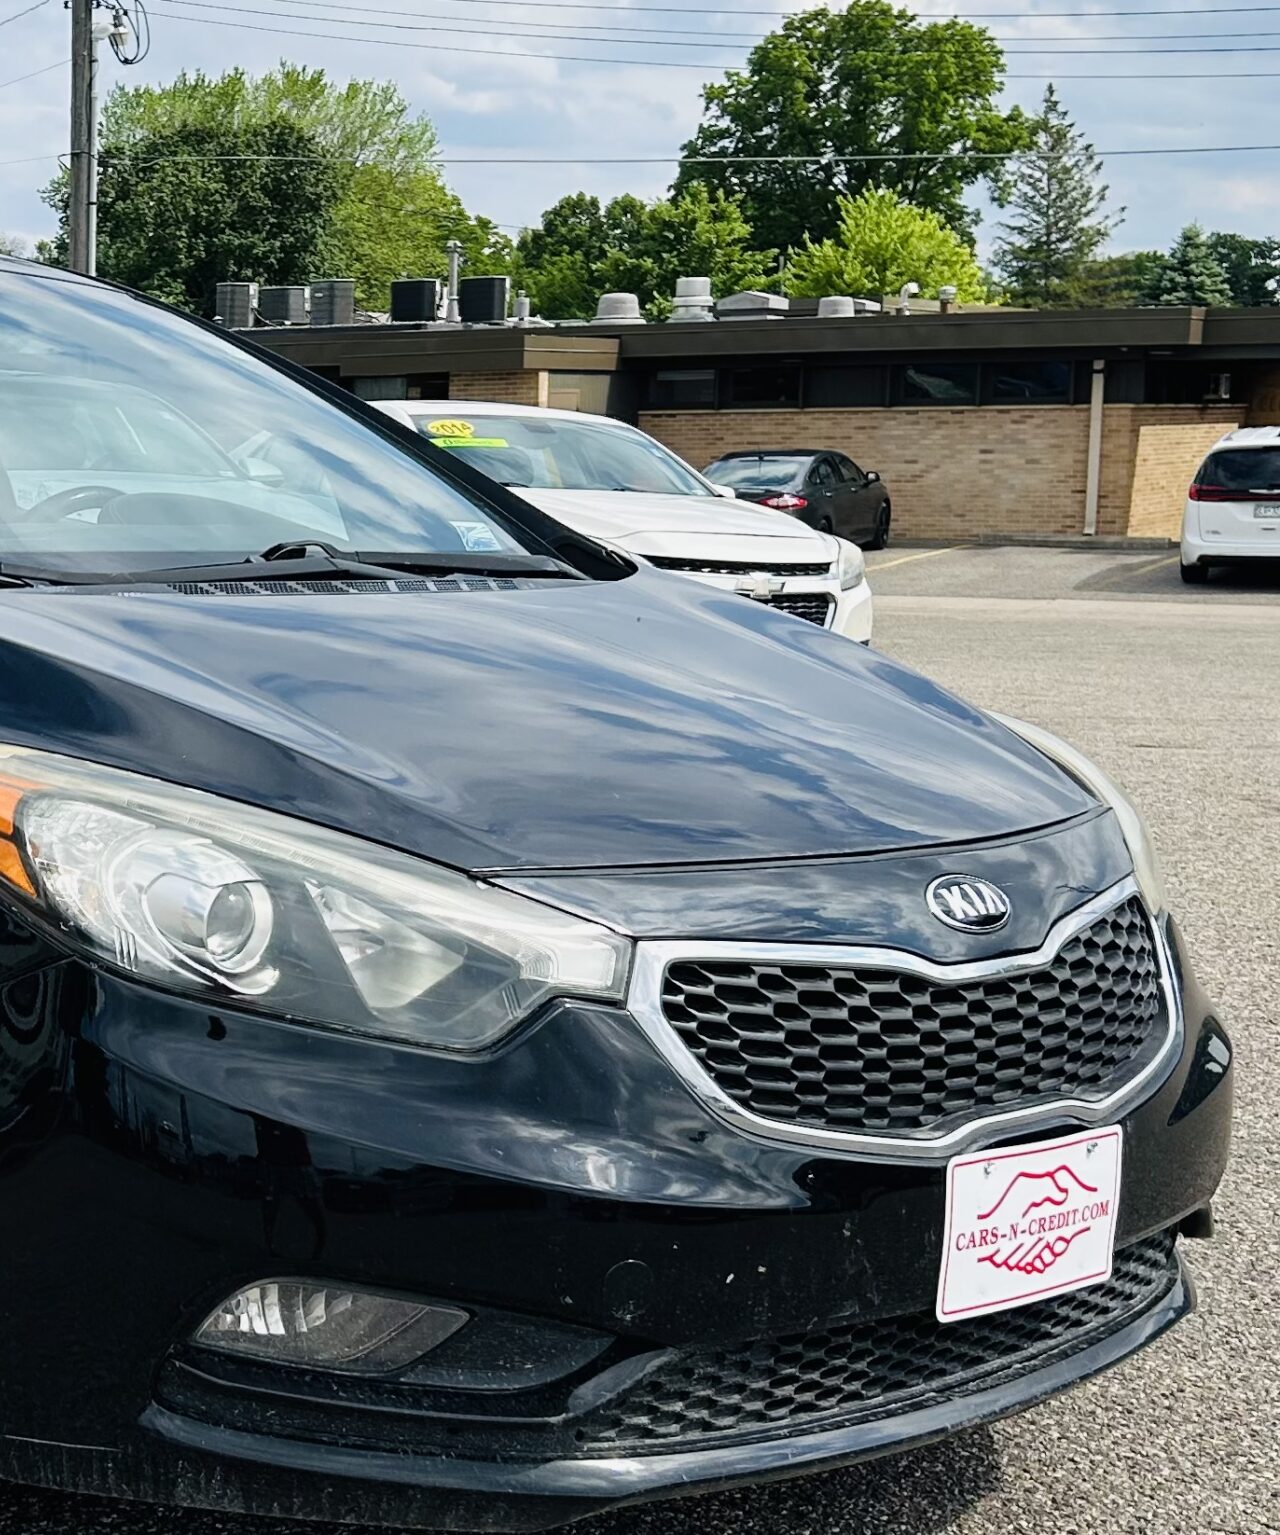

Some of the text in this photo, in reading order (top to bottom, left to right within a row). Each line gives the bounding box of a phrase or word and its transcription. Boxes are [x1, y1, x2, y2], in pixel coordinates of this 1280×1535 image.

[430, 422, 472, 435] 2014
[937, 882, 1007, 920] KIA
[955, 1199, 1110, 1251] CARS-N-CREDIT.COM
